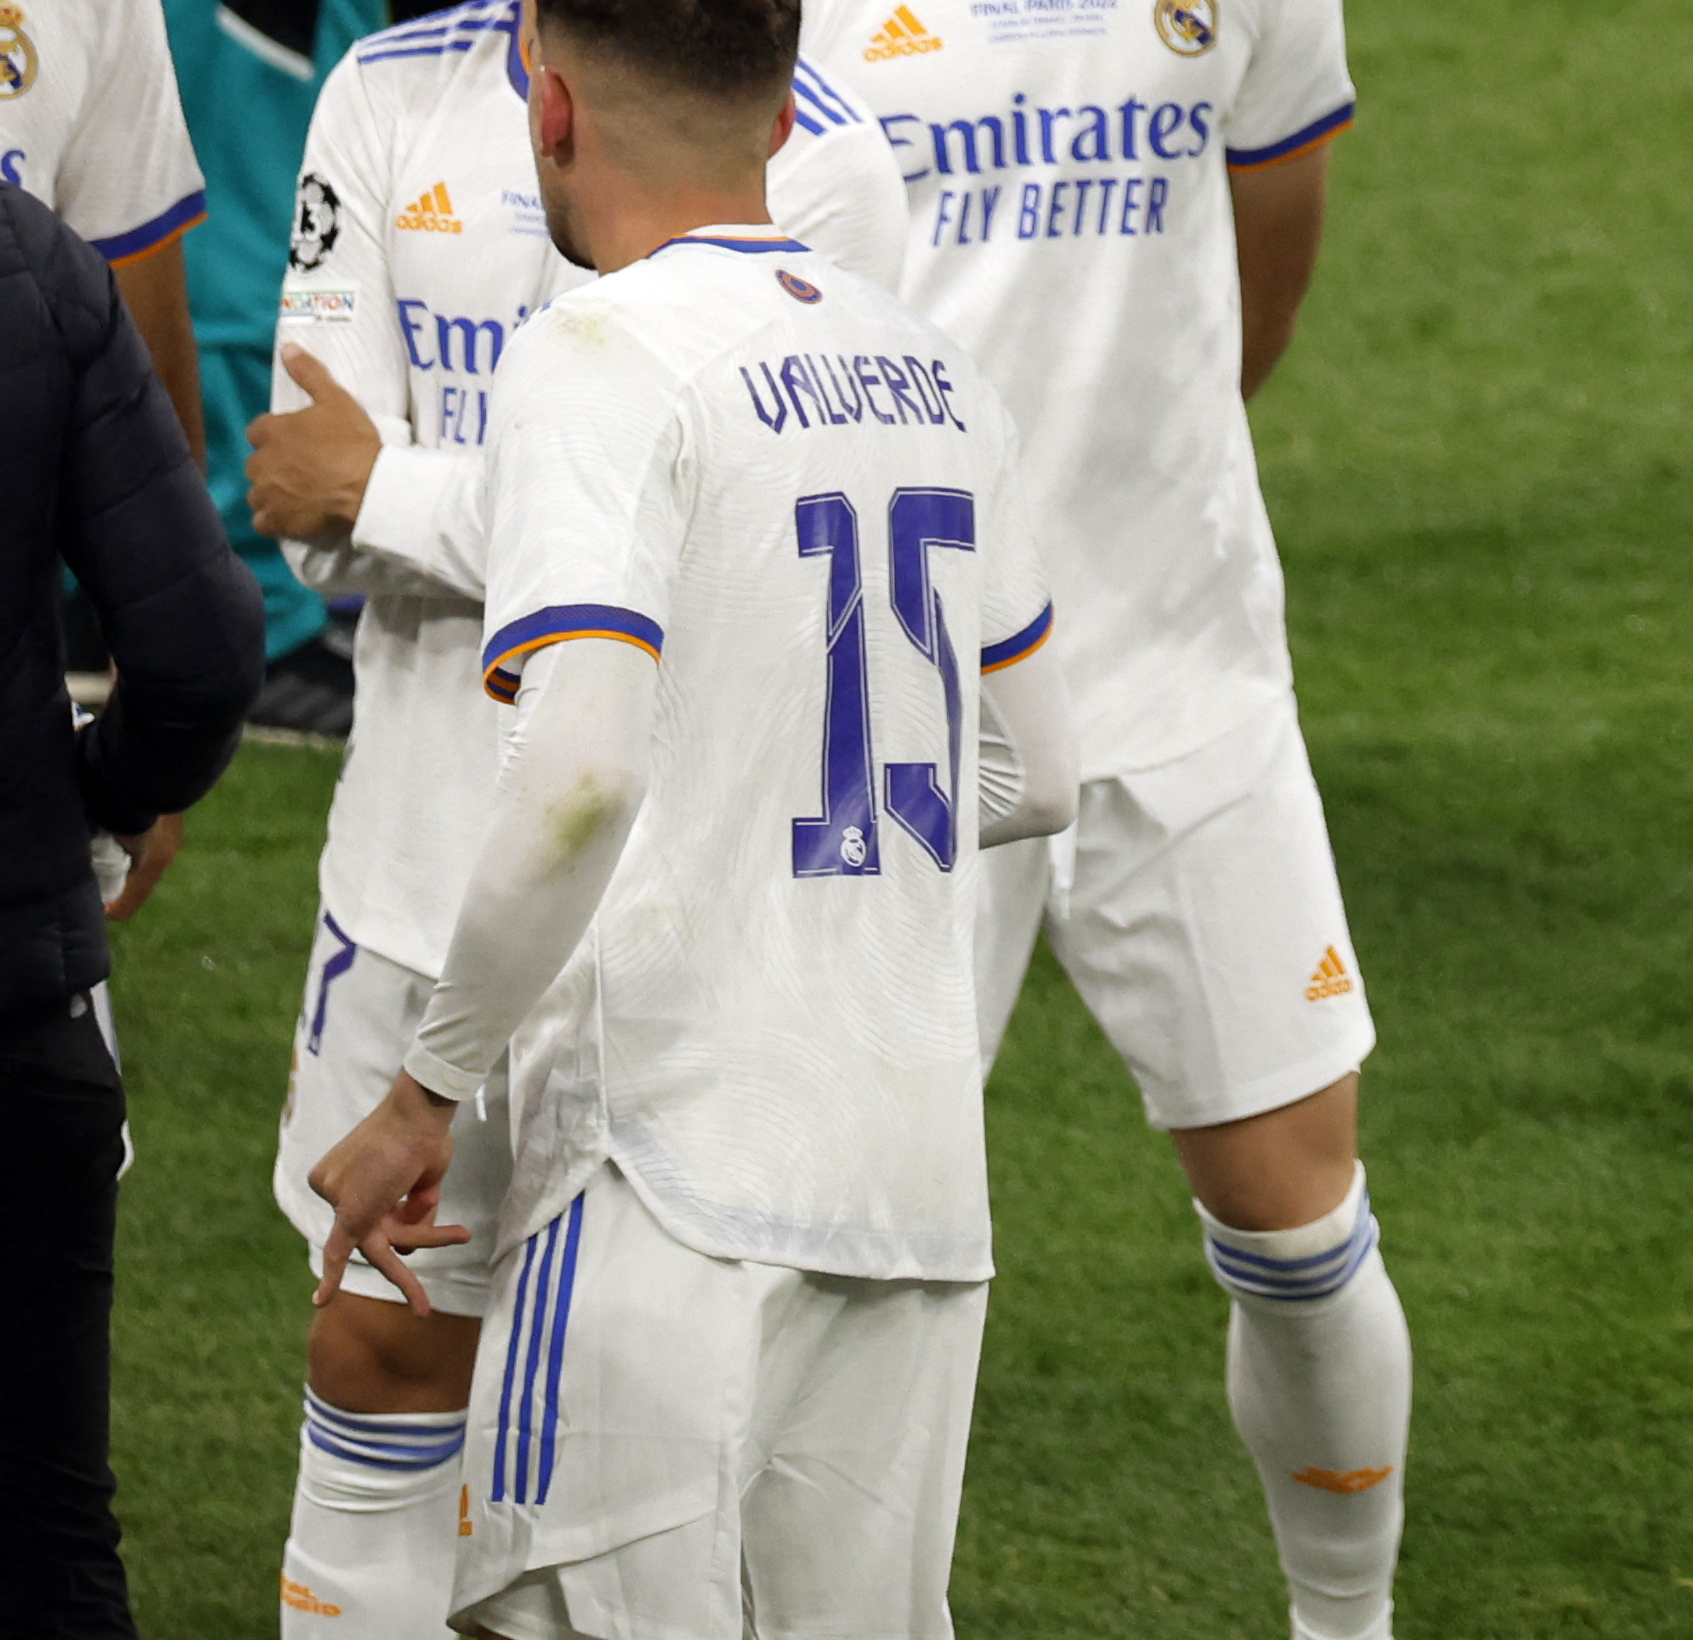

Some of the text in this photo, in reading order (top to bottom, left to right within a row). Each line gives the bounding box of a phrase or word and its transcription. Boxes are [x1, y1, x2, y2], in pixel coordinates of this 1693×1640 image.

[863, 37, 944, 62] adidas
[878, 91, 1213, 183] Emirates
[395, 215, 463, 235] adidas
[932, 177, 1170, 246] FLY BETTER
[740, 353, 967, 434] VALVERDE
[792, 486, 977, 879] 15
